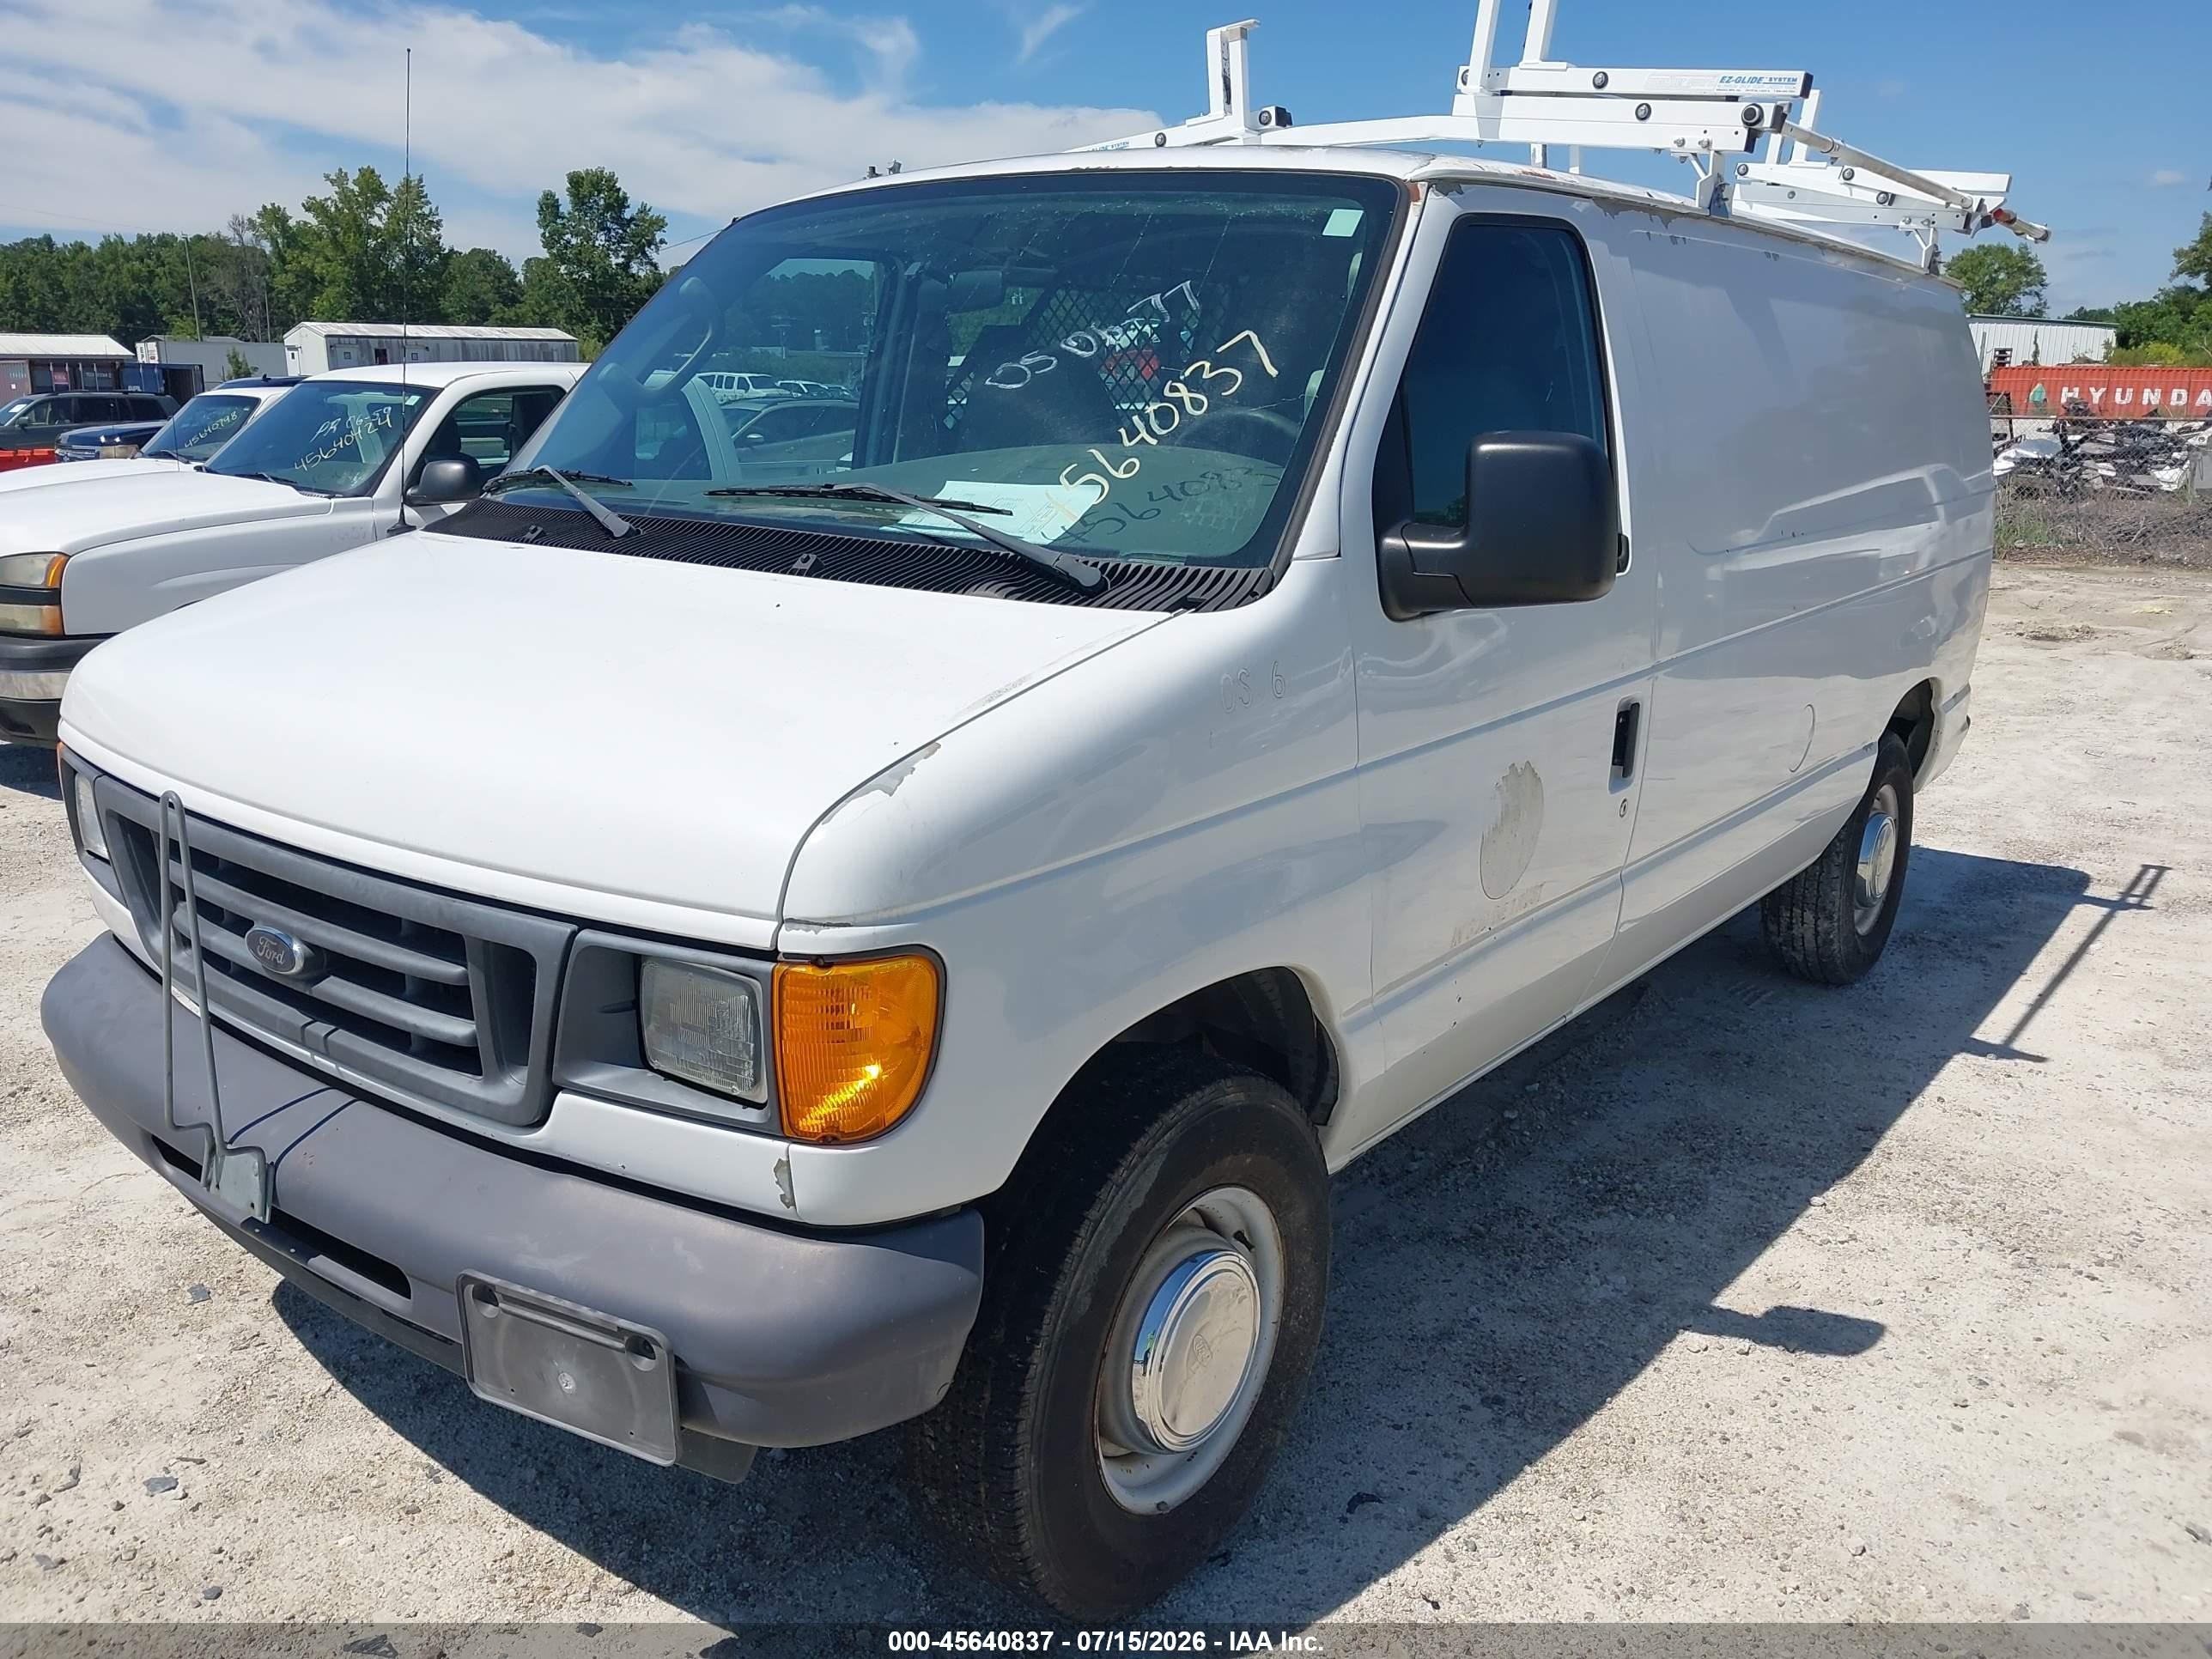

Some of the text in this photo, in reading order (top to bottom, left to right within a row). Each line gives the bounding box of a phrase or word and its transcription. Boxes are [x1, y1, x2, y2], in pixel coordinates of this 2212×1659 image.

[1719, 75, 1765, 84] EZ-GLIDE
[184, 410, 238, 448] 45640798
[295, 413, 392, 471] 45640424
[1045, 330, 1279, 521] 45640837
[258, 936, 285, 964] Ford
